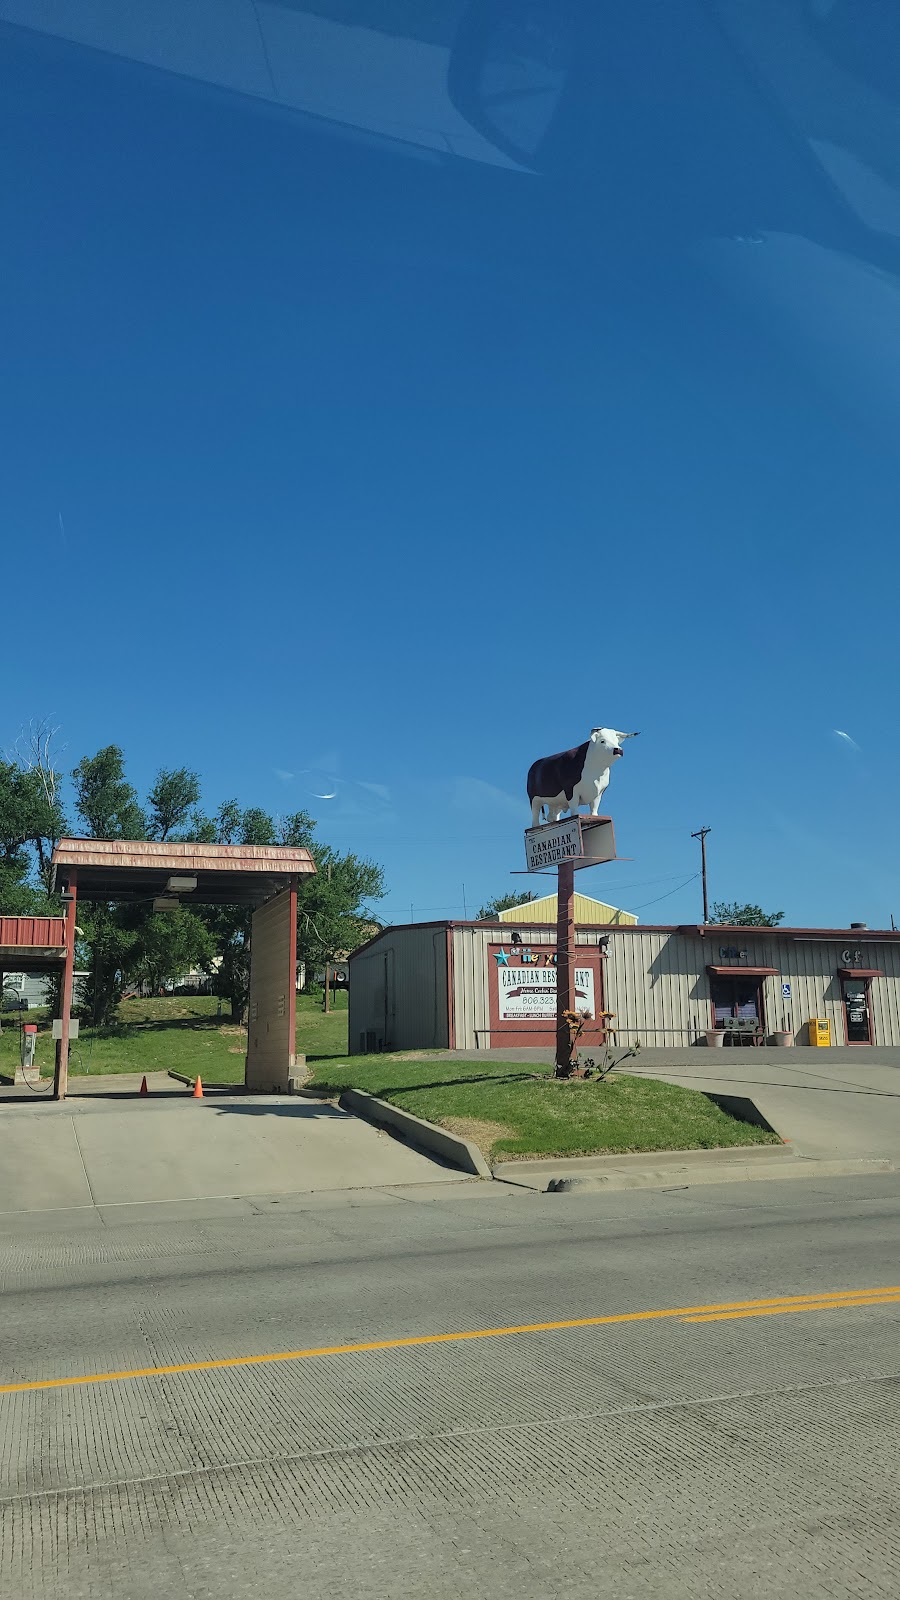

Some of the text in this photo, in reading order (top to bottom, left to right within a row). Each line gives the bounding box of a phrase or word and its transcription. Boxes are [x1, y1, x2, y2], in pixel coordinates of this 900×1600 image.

[532, 833, 572, 854] CANADIAN
[530, 843, 577, 868] RESTAURANT
[502, 970, 540, 987] CANADIAN
